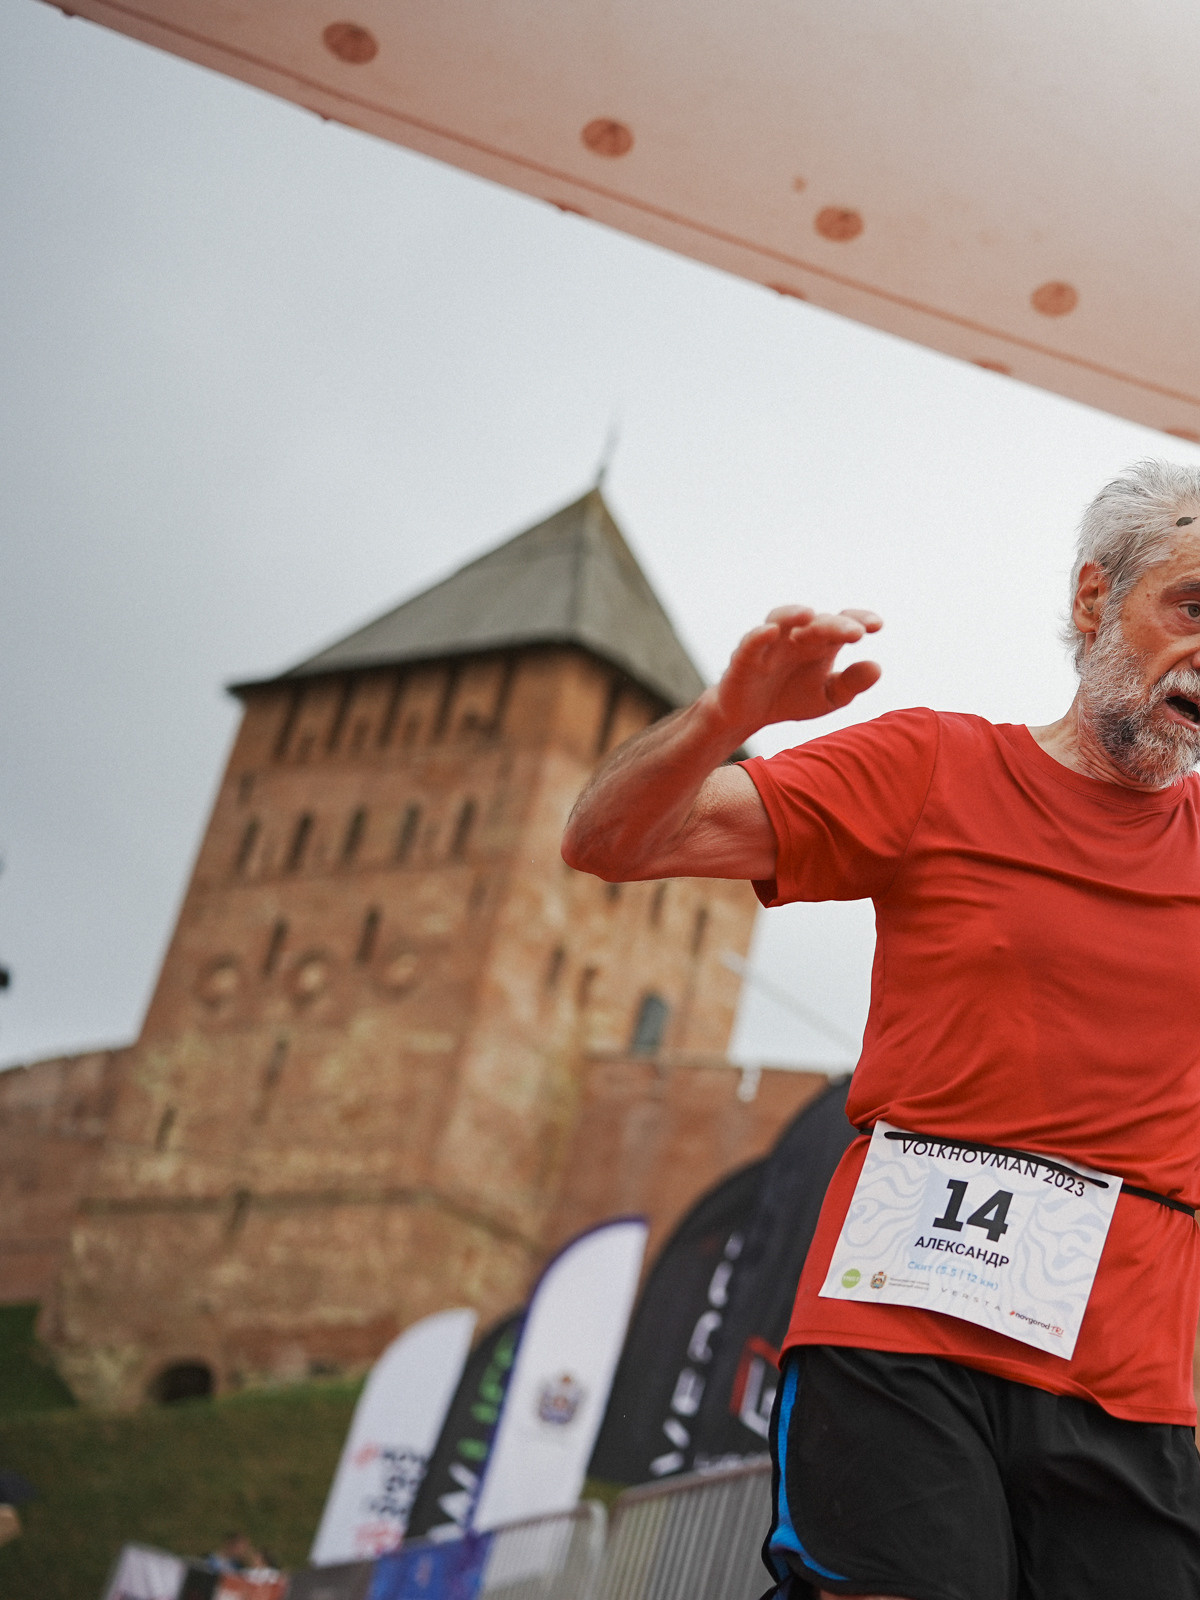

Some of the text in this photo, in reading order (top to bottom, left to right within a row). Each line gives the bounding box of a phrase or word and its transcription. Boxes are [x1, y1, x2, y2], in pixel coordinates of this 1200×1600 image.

[902, 1140, 1086, 1197] VOLKHOVMAN 2023
[932, 1179, 1014, 1243] 14
[914, 1236, 1010, 1268] АЛЕКСАНДР
[967, 1272, 978, 1283] 12
[941, 1288, 1000, 1311] VERSTA
